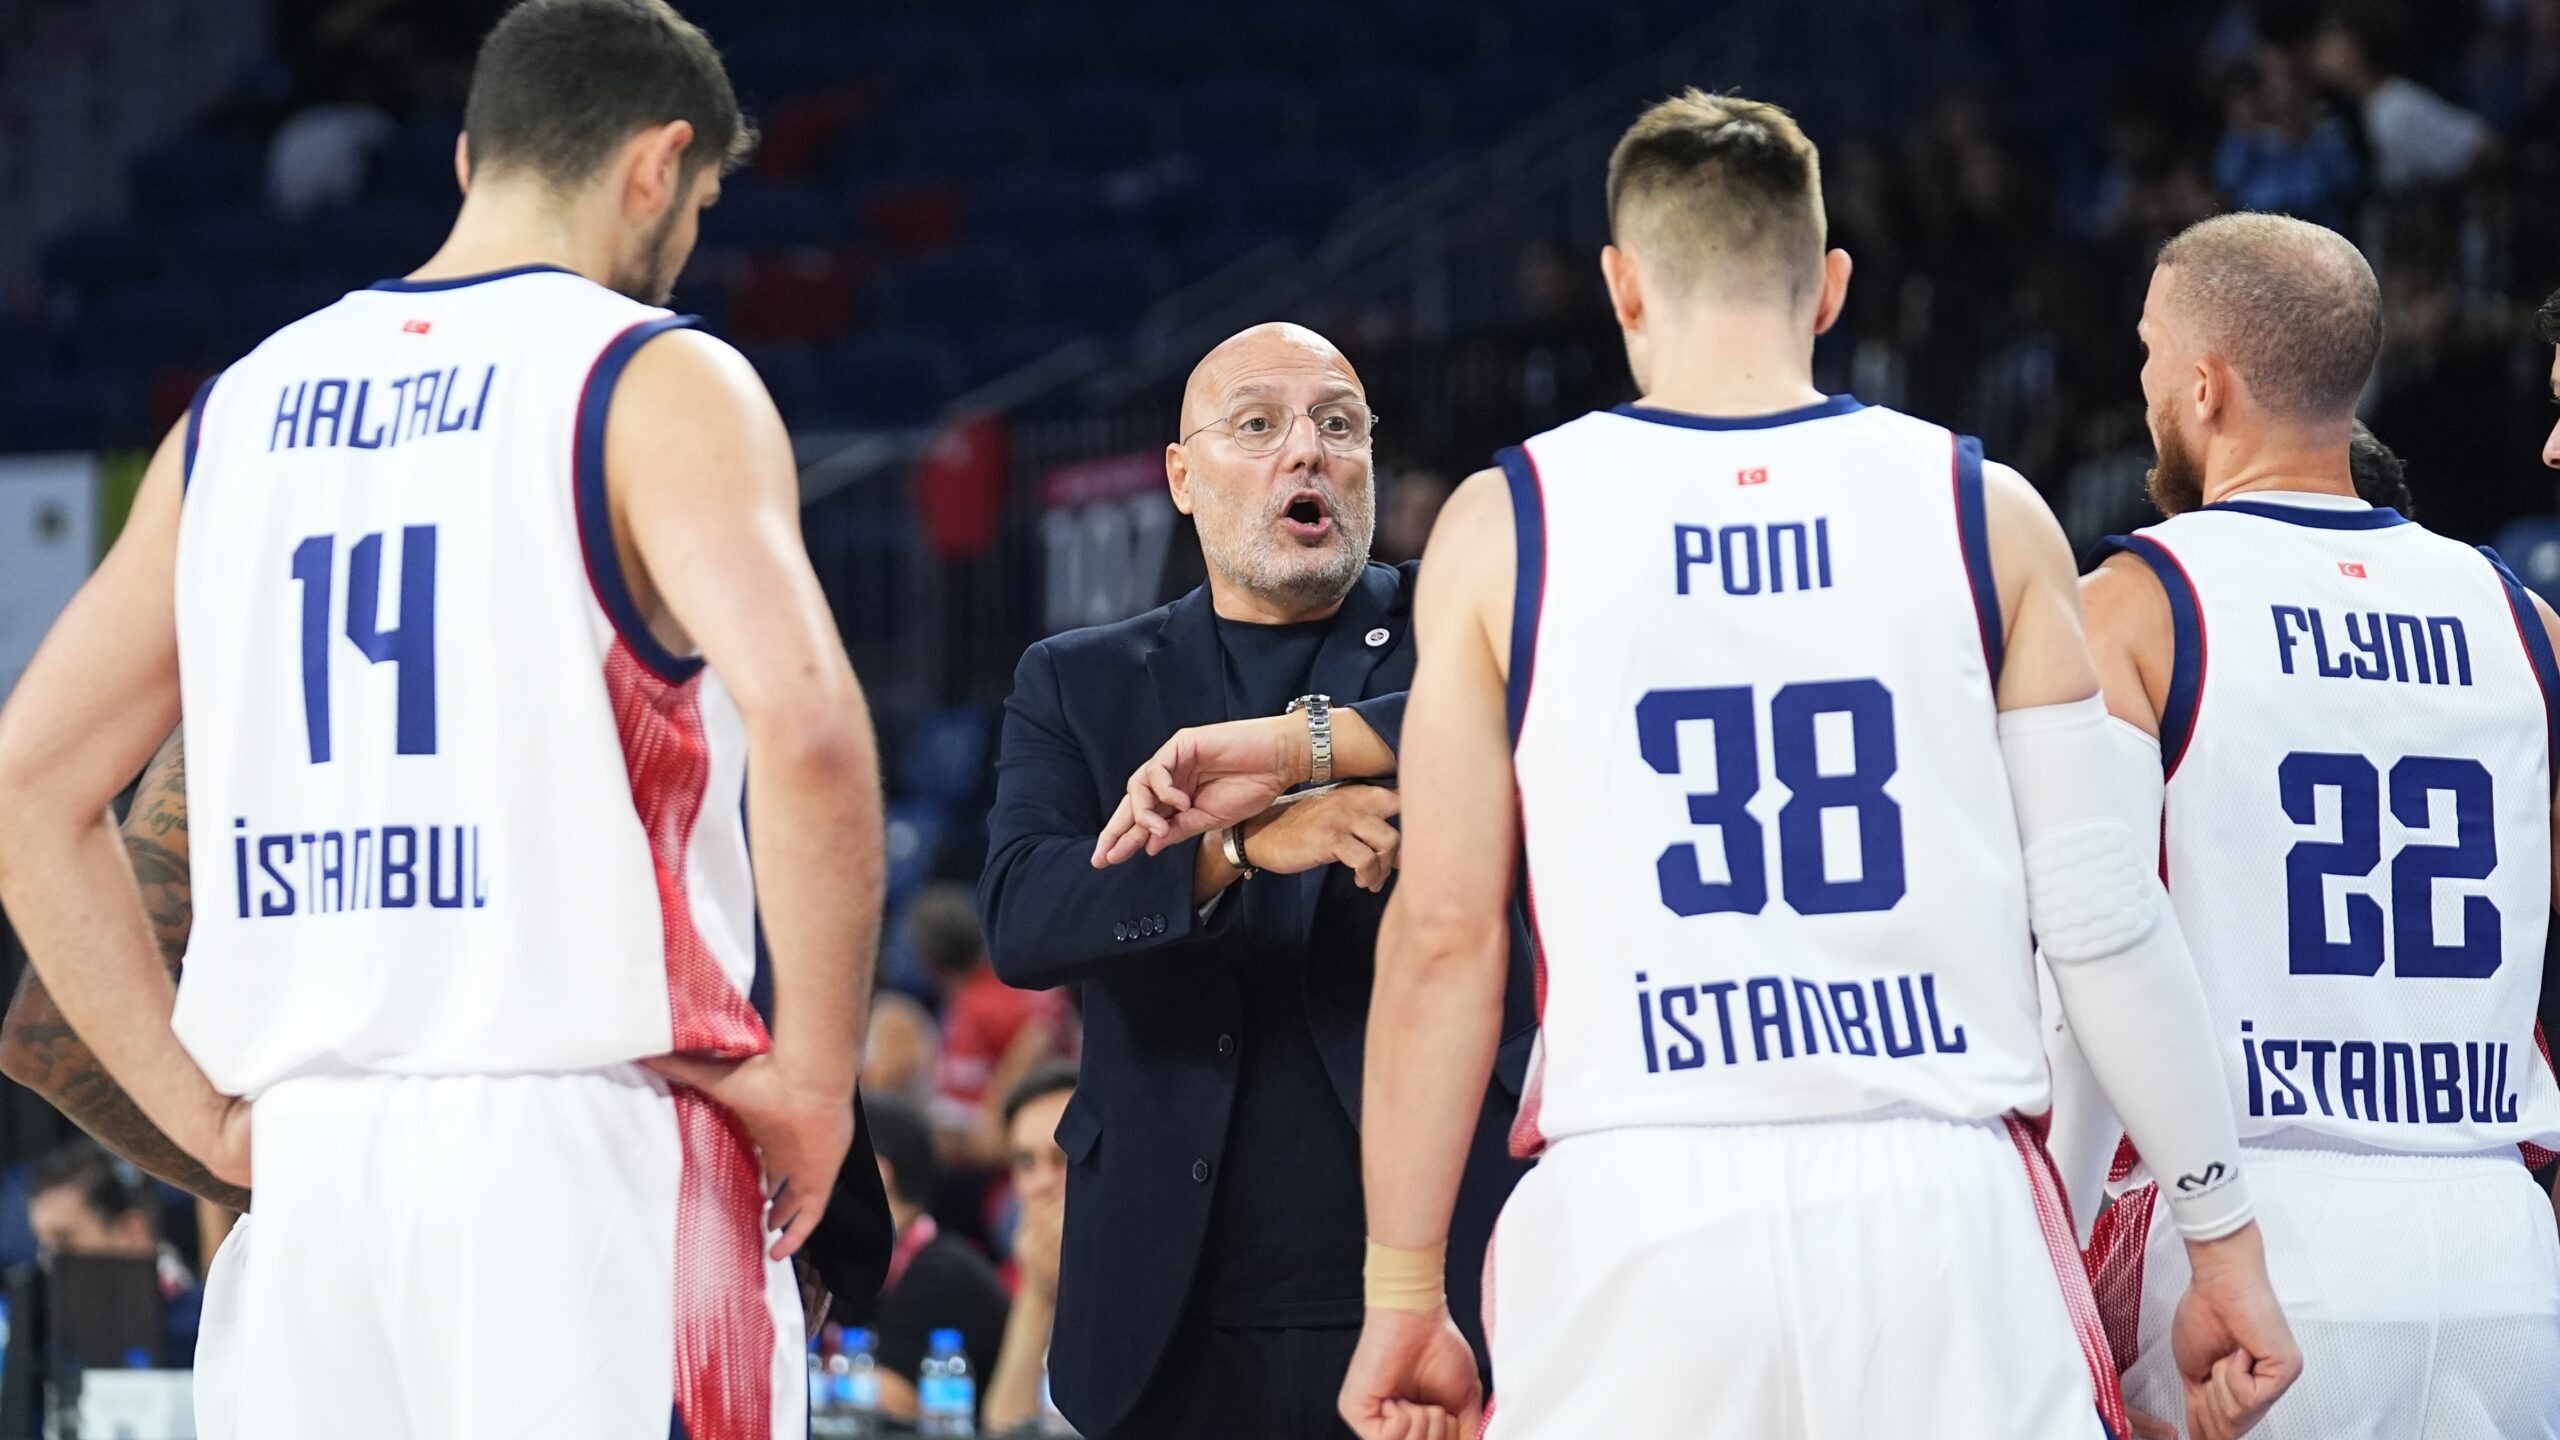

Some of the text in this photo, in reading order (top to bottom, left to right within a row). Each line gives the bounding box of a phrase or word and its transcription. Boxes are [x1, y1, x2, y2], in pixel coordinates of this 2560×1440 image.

[270, 365, 496, 452] HALTALI
[1673, 517, 1833, 596] PONI
[291, 523, 438, 765] 14
[2270, 604, 2473, 687] FLYNN
[1634, 677, 1907, 918] 38
[234, 817, 487, 919] İSTANBUL
[2277, 750, 2503, 980] 22
[1635, 971, 1968, 1074] İSTANBUL
[2241, 1019, 2518, 1125] İSTANBUL
